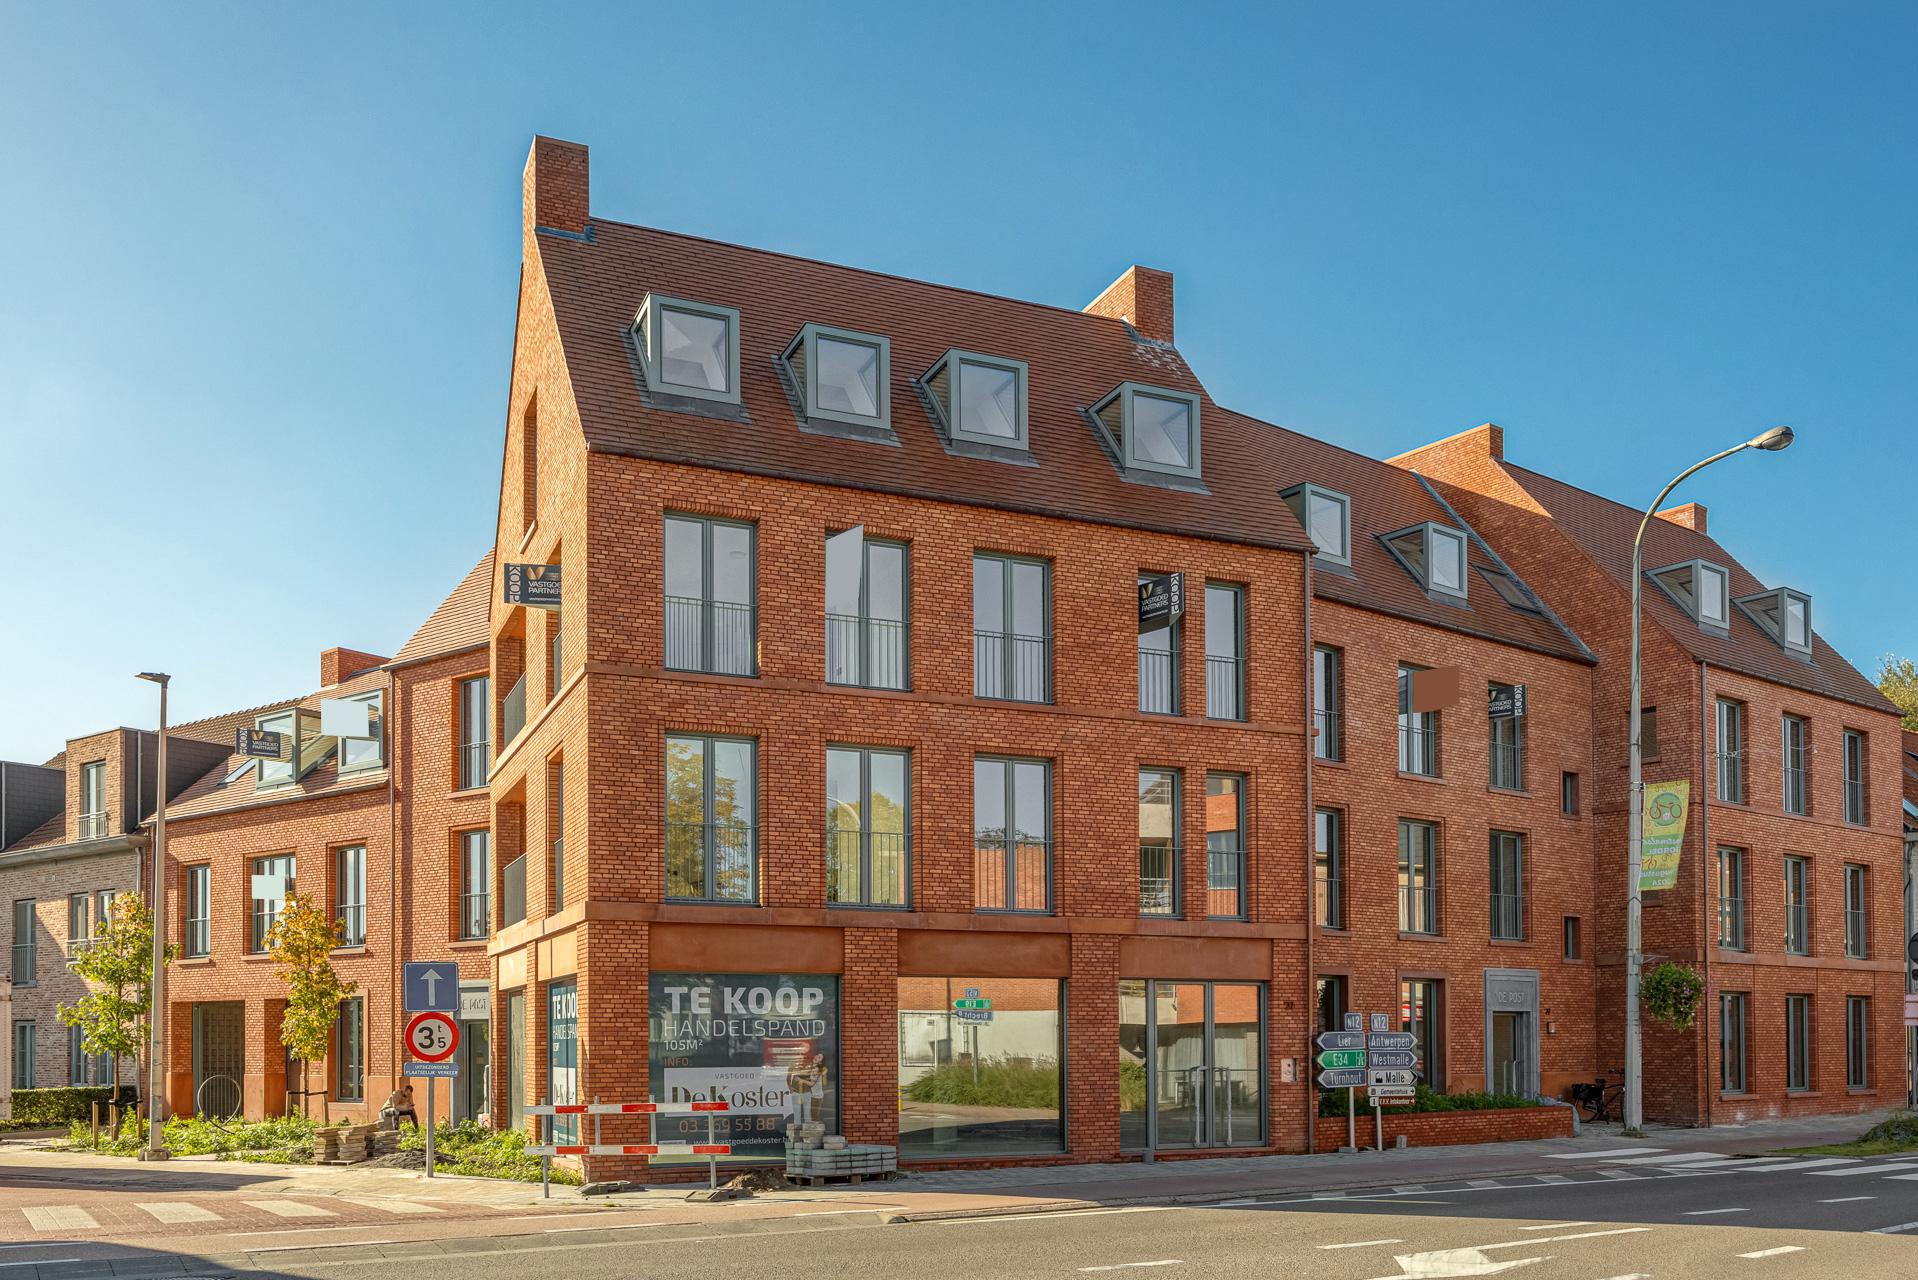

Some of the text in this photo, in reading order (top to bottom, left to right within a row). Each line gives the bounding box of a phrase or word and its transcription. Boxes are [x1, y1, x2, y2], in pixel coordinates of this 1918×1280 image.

[509, 564, 521, 603] KOOP
[1171, 573, 1180, 614] KOOP
[1514, 685, 1523, 715] KOOP
[663, 987, 823, 1015] TE KOOP
[1498, 991, 1525, 1003] DE POST
[469, 998, 486, 1010] POST
[552, 995, 561, 1020] TE
[1347, 1015, 1360, 1028] N12
[1373, 1016, 1386, 1029] N12
[663, 1020, 825, 1037] HANDELSPAND
[1338, 1035, 1351, 1046] Lier
[1371, 1034, 1410, 1048] Antwerpen
[1333, 1053, 1348, 1066] E34
[1372, 1055, 1410, 1065] Westmalle
[1330, 1071, 1362, 1084] Turnhout
[1385, 1071, 1405, 1083] Malle
[679, 1119, 699, 1133] 03
[735, 1118, 752, 1131] 55
[756, 1116, 776, 1130] 88
